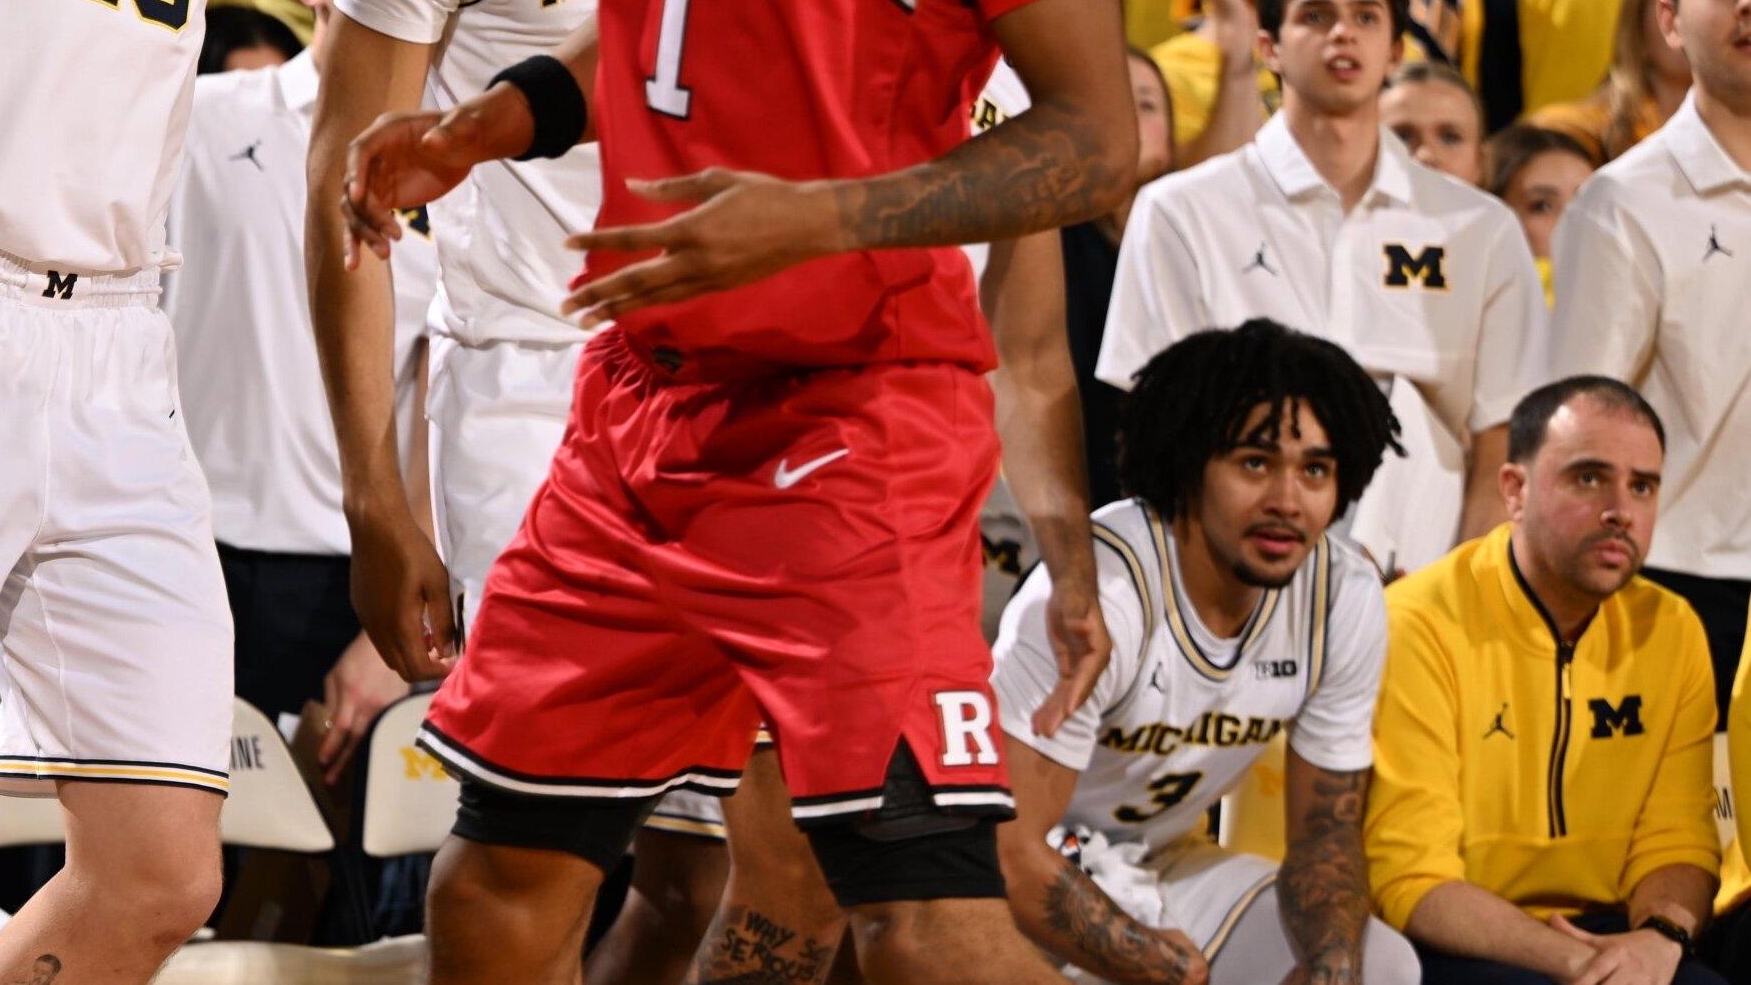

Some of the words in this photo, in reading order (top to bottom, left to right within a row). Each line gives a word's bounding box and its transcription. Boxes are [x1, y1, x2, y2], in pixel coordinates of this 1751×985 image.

[43, 270, 78, 300] M
[1381, 241, 1448, 289] M
[935, 690, 999, 766] R
[1587, 695, 1645, 739] M
[1114, 771, 1203, 823] 3
